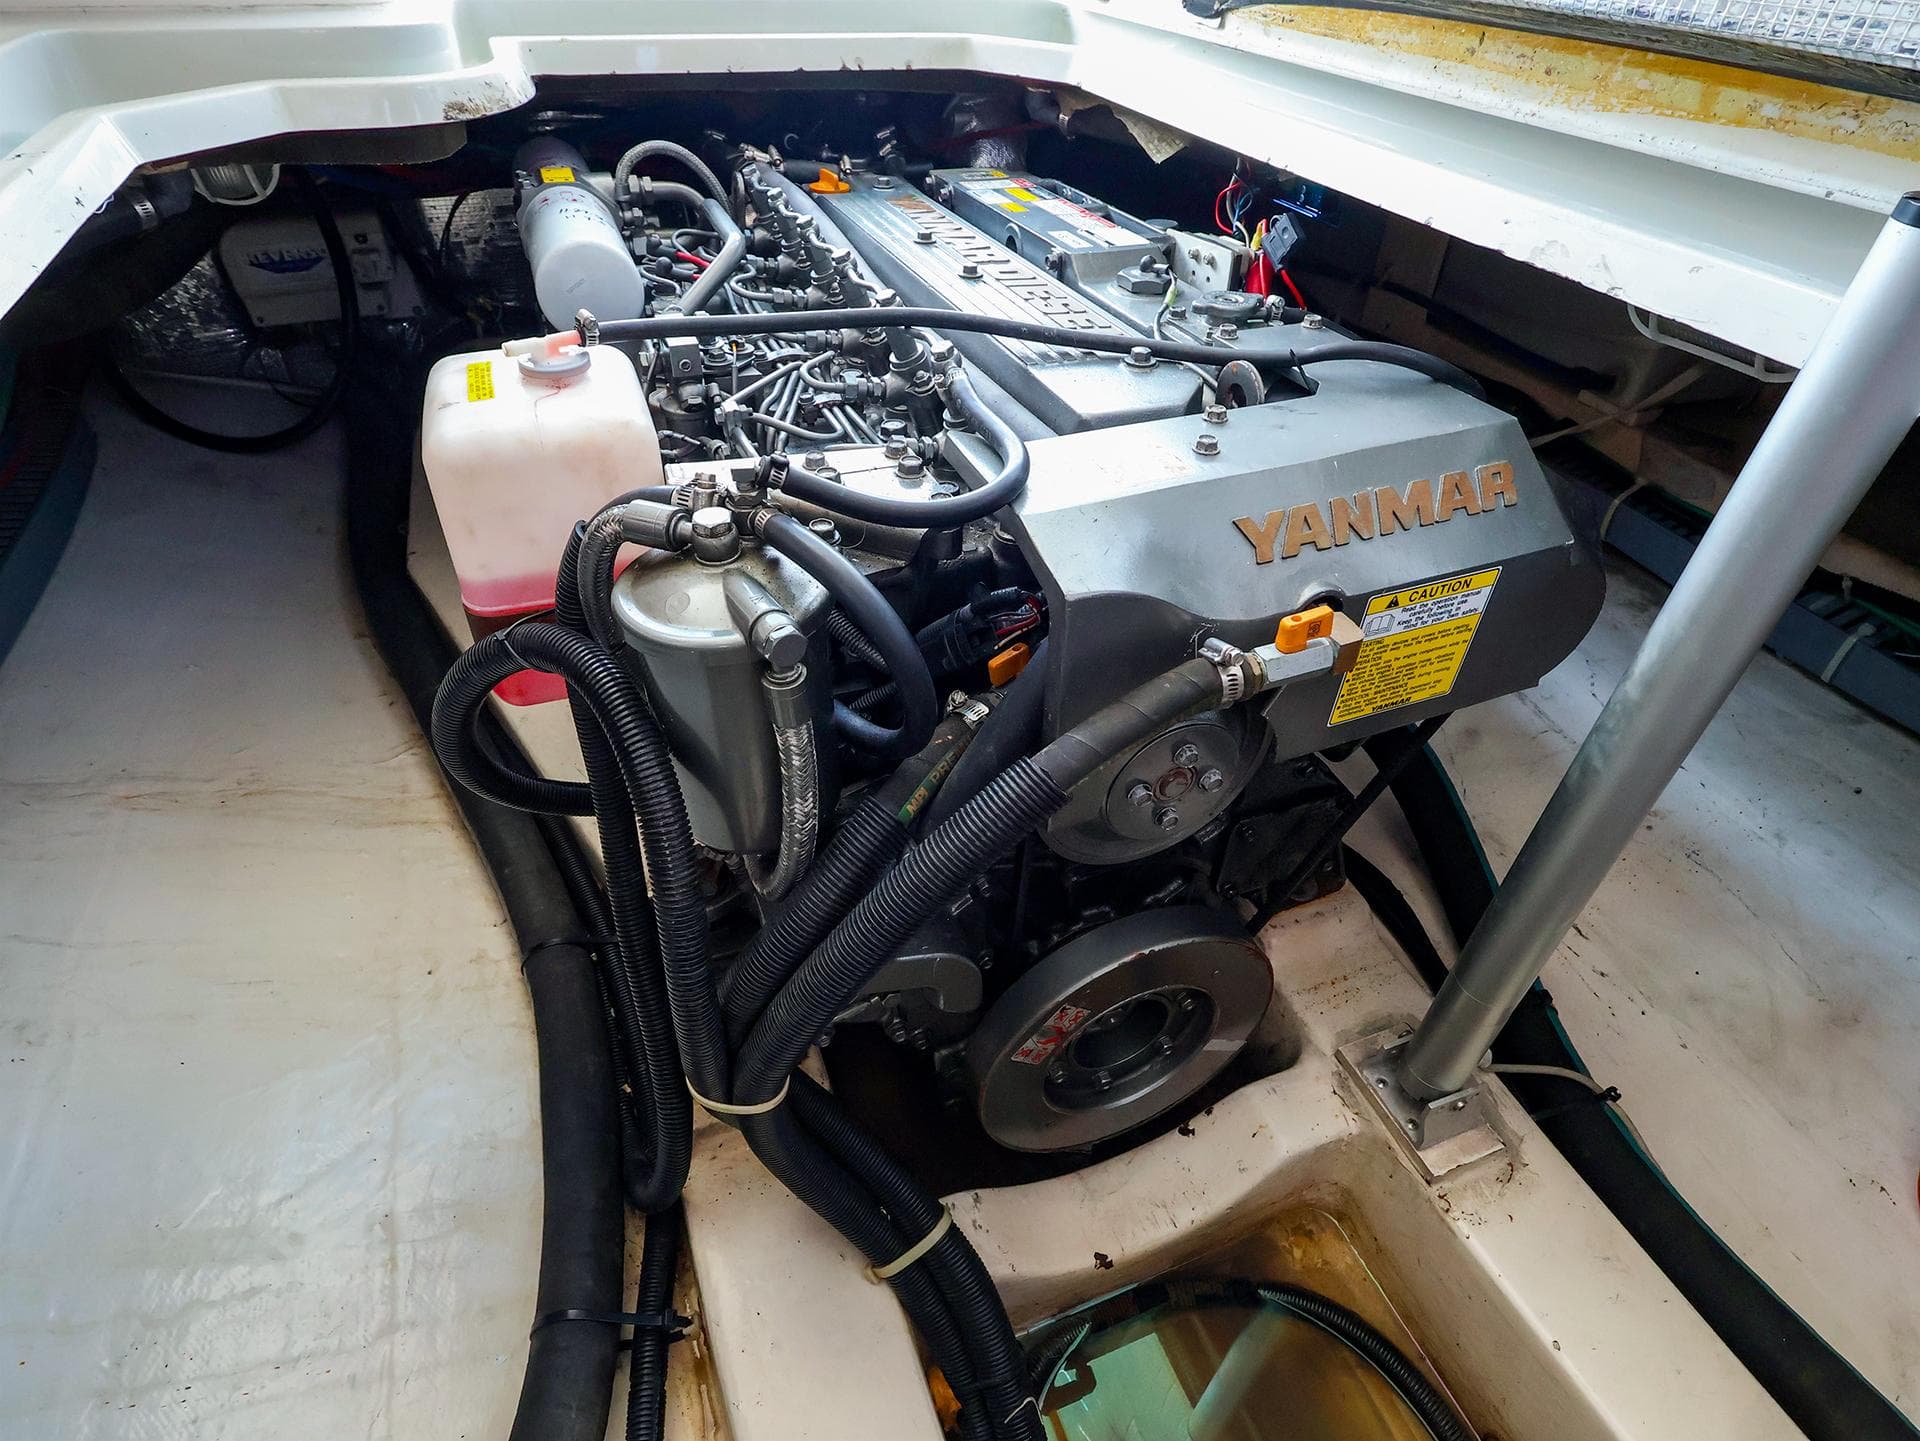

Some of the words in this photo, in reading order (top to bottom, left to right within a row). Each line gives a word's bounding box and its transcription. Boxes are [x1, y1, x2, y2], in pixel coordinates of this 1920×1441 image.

[1233, 460, 1518, 564] YANMAR
[1409, 577, 1472, 602] CAUTION
[1401, 604, 1417, 613] Read
[1431, 595, 1457, 607] operation
[1460, 589, 1480, 598] manual
[1409, 607, 1432, 617] carefully
[1436, 601, 1454, 610] before
[1397, 618, 1412, 626] Keep
[1427, 608, 1452, 619] following
[1361, 638, 1384, 648] TARTING
[1372, 696, 1411, 711] YANMAR
